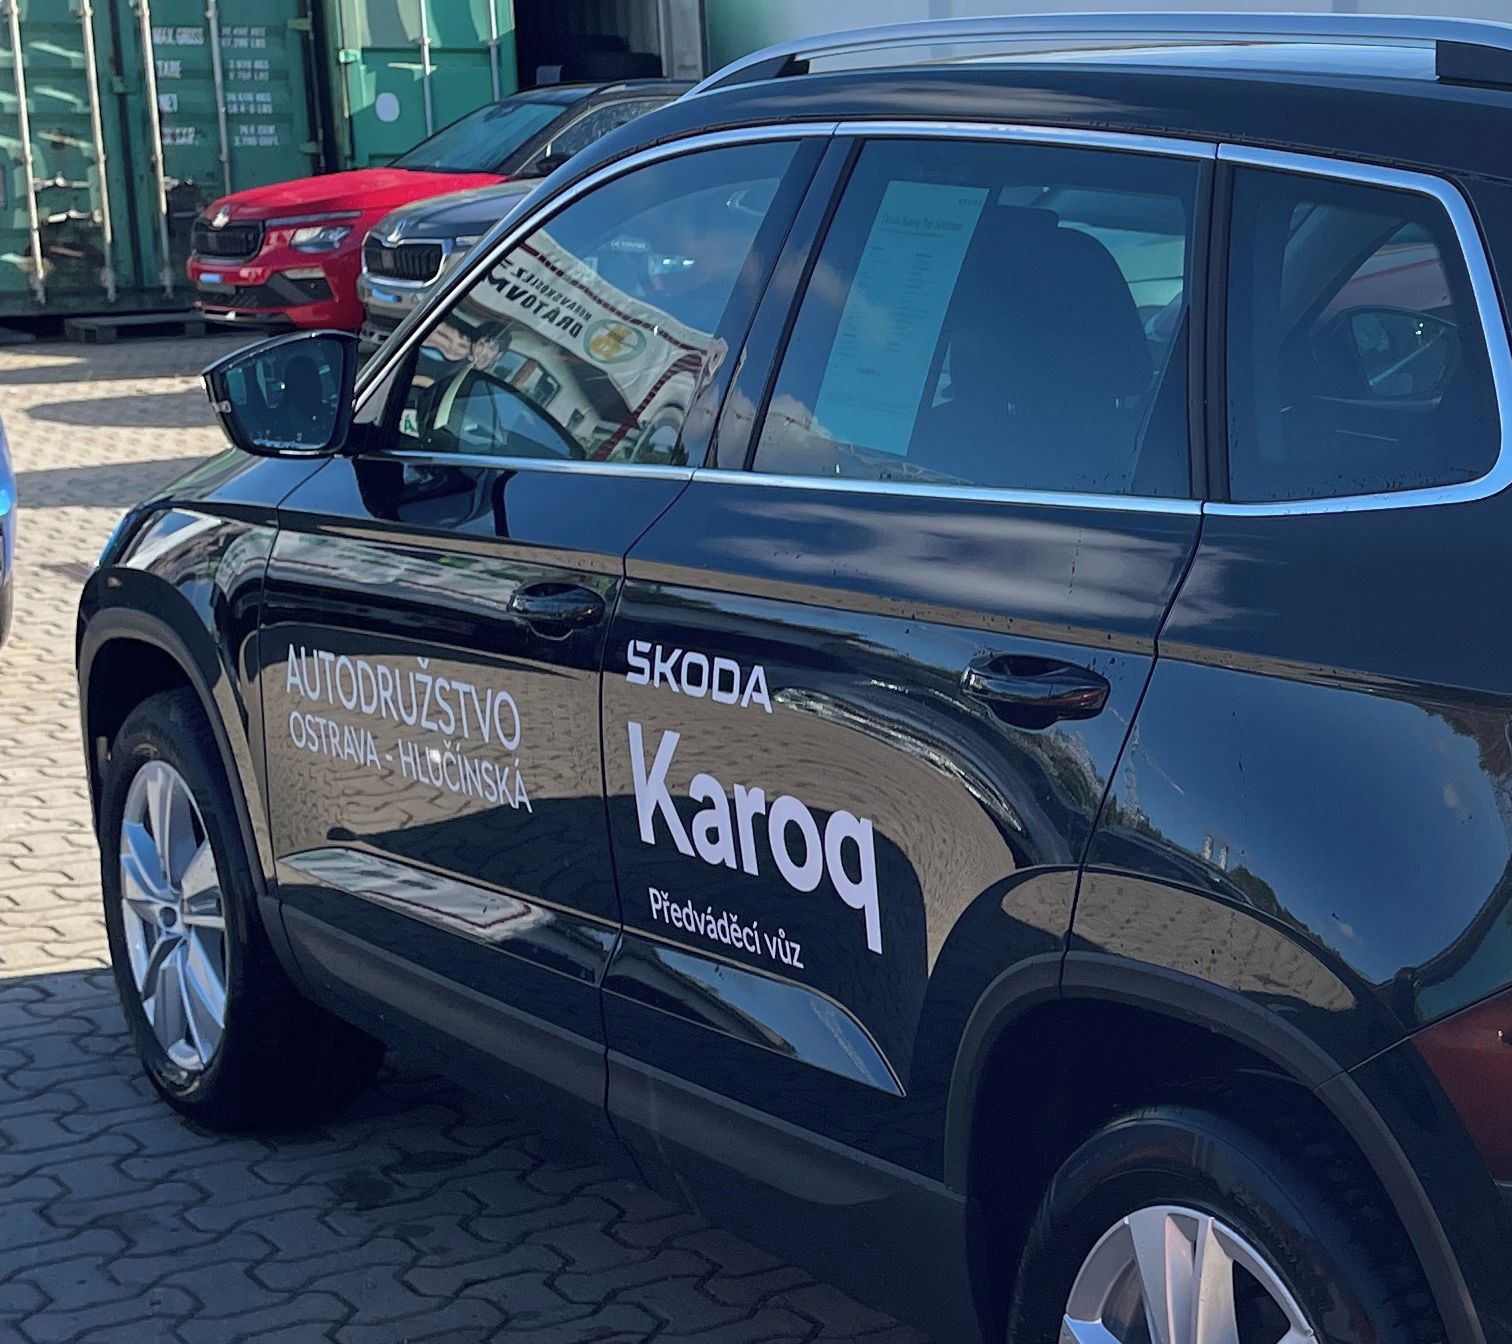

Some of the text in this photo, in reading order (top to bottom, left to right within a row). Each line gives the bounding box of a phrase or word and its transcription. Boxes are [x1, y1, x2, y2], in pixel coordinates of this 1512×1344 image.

[286, 642, 522, 752] AUTODRUŽSTVO
[289, 710, 381, 771] OSTRAVA
[397, 738, 534, 814] HLUČÍNSKÁ
[627, 720, 883, 955] Karoq
[649, 886, 804, 970] Předváděcí vůz
